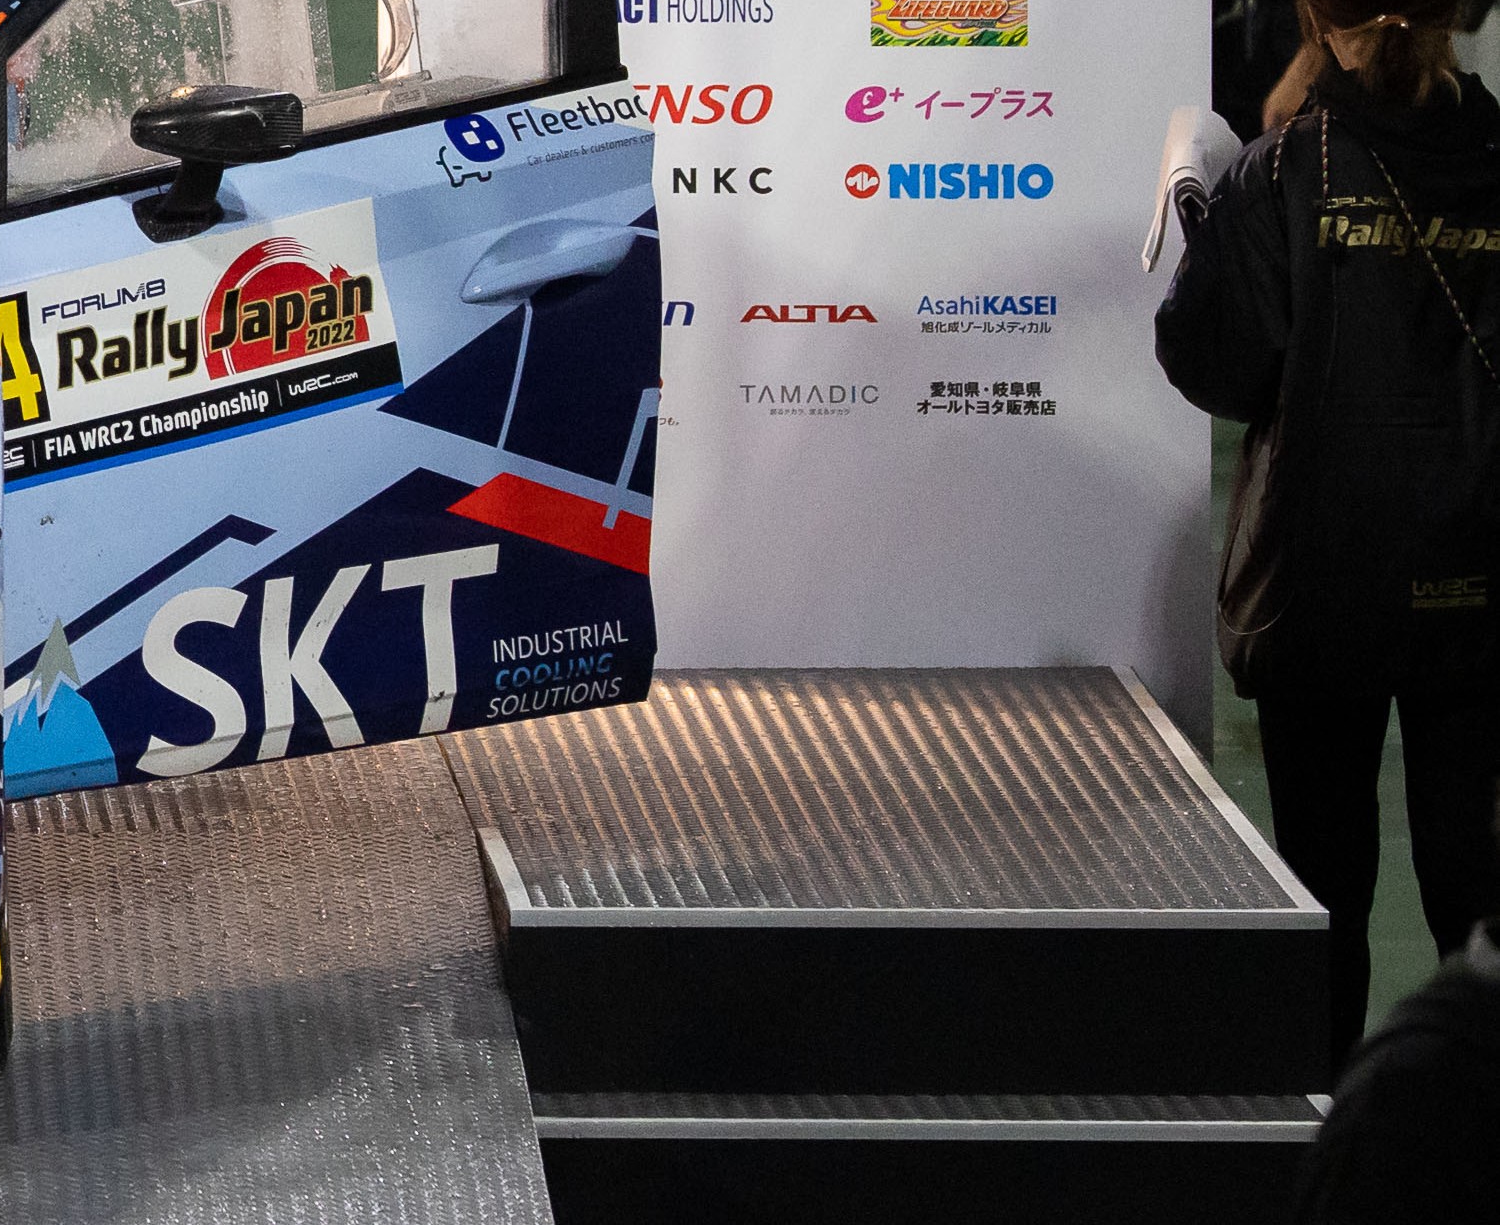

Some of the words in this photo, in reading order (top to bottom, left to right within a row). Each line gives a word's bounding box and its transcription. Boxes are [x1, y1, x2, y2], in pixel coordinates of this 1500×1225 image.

[915, 89, 1055, 119] イープラス
[527, 154, 544, 167] Car
[545, 146, 579, 164] dealers
[581, 145, 589, 155] &
[590, 136, 638, 153] customers
[672, 167, 774, 194] NKC
[888, 162, 1055, 200] NISHIO
[1317, 214, 1408, 256] Rally
[41, 278, 166, 324] FORUM8
[740, 304, 879, 324] ALTIA
[917, 295, 1058, 316] AsahiKASEI
[56, 305, 199, 392] Rally
[209, 273, 374, 355] Japan
[306, 319, 355, 350] 2022
[921, 321, 1052, 333] 旭化成ゾールメディカル
[740, 384, 879, 404] TAMADIC
[930, 381, 1042, 398] 愛知県・岐阜県
[916, 399, 1057, 416] オールトヨタ販売店
[44, 434, 77, 461] FIA
[79, 419, 134, 451] WRC2
[140, 388, 269, 439] Championship
[493, 620, 629, 663] INDUSTRIAL
[136, 543, 499, 776] SKT
[495, 652, 614, 691] COOLING
[487, 677, 623, 718] SOLUTIONS
